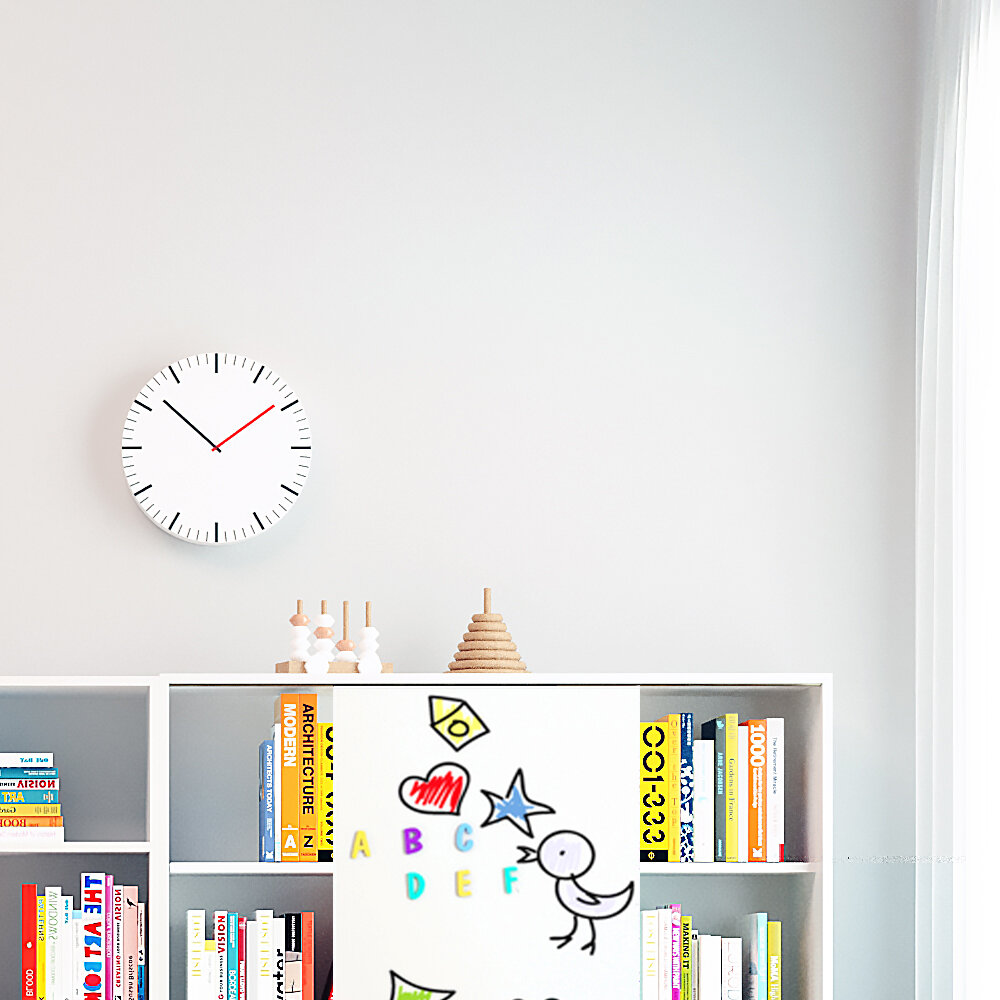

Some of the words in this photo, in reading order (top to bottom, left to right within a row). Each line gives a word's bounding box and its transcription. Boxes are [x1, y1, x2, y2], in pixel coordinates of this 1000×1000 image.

[284, 703, 297, 767] MODERN
[750, 724, 766, 767] 1000
[265, 745, 273, 787] ARCHITECTS
[303, 703, 315, 815] ARCHITECTURE
[350, 830, 371, 859] A
[403, 828, 423, 854] B
[455, 823, 474, 852] C
[406, 872, 425, 900] D
[456, 870, 472, 897] E
[502, 867, 518, 894] F
[218, 915, 226, 954] VISION
[683, 960, 690, 969] IT
[770, 955, 779, 982] MoMA
